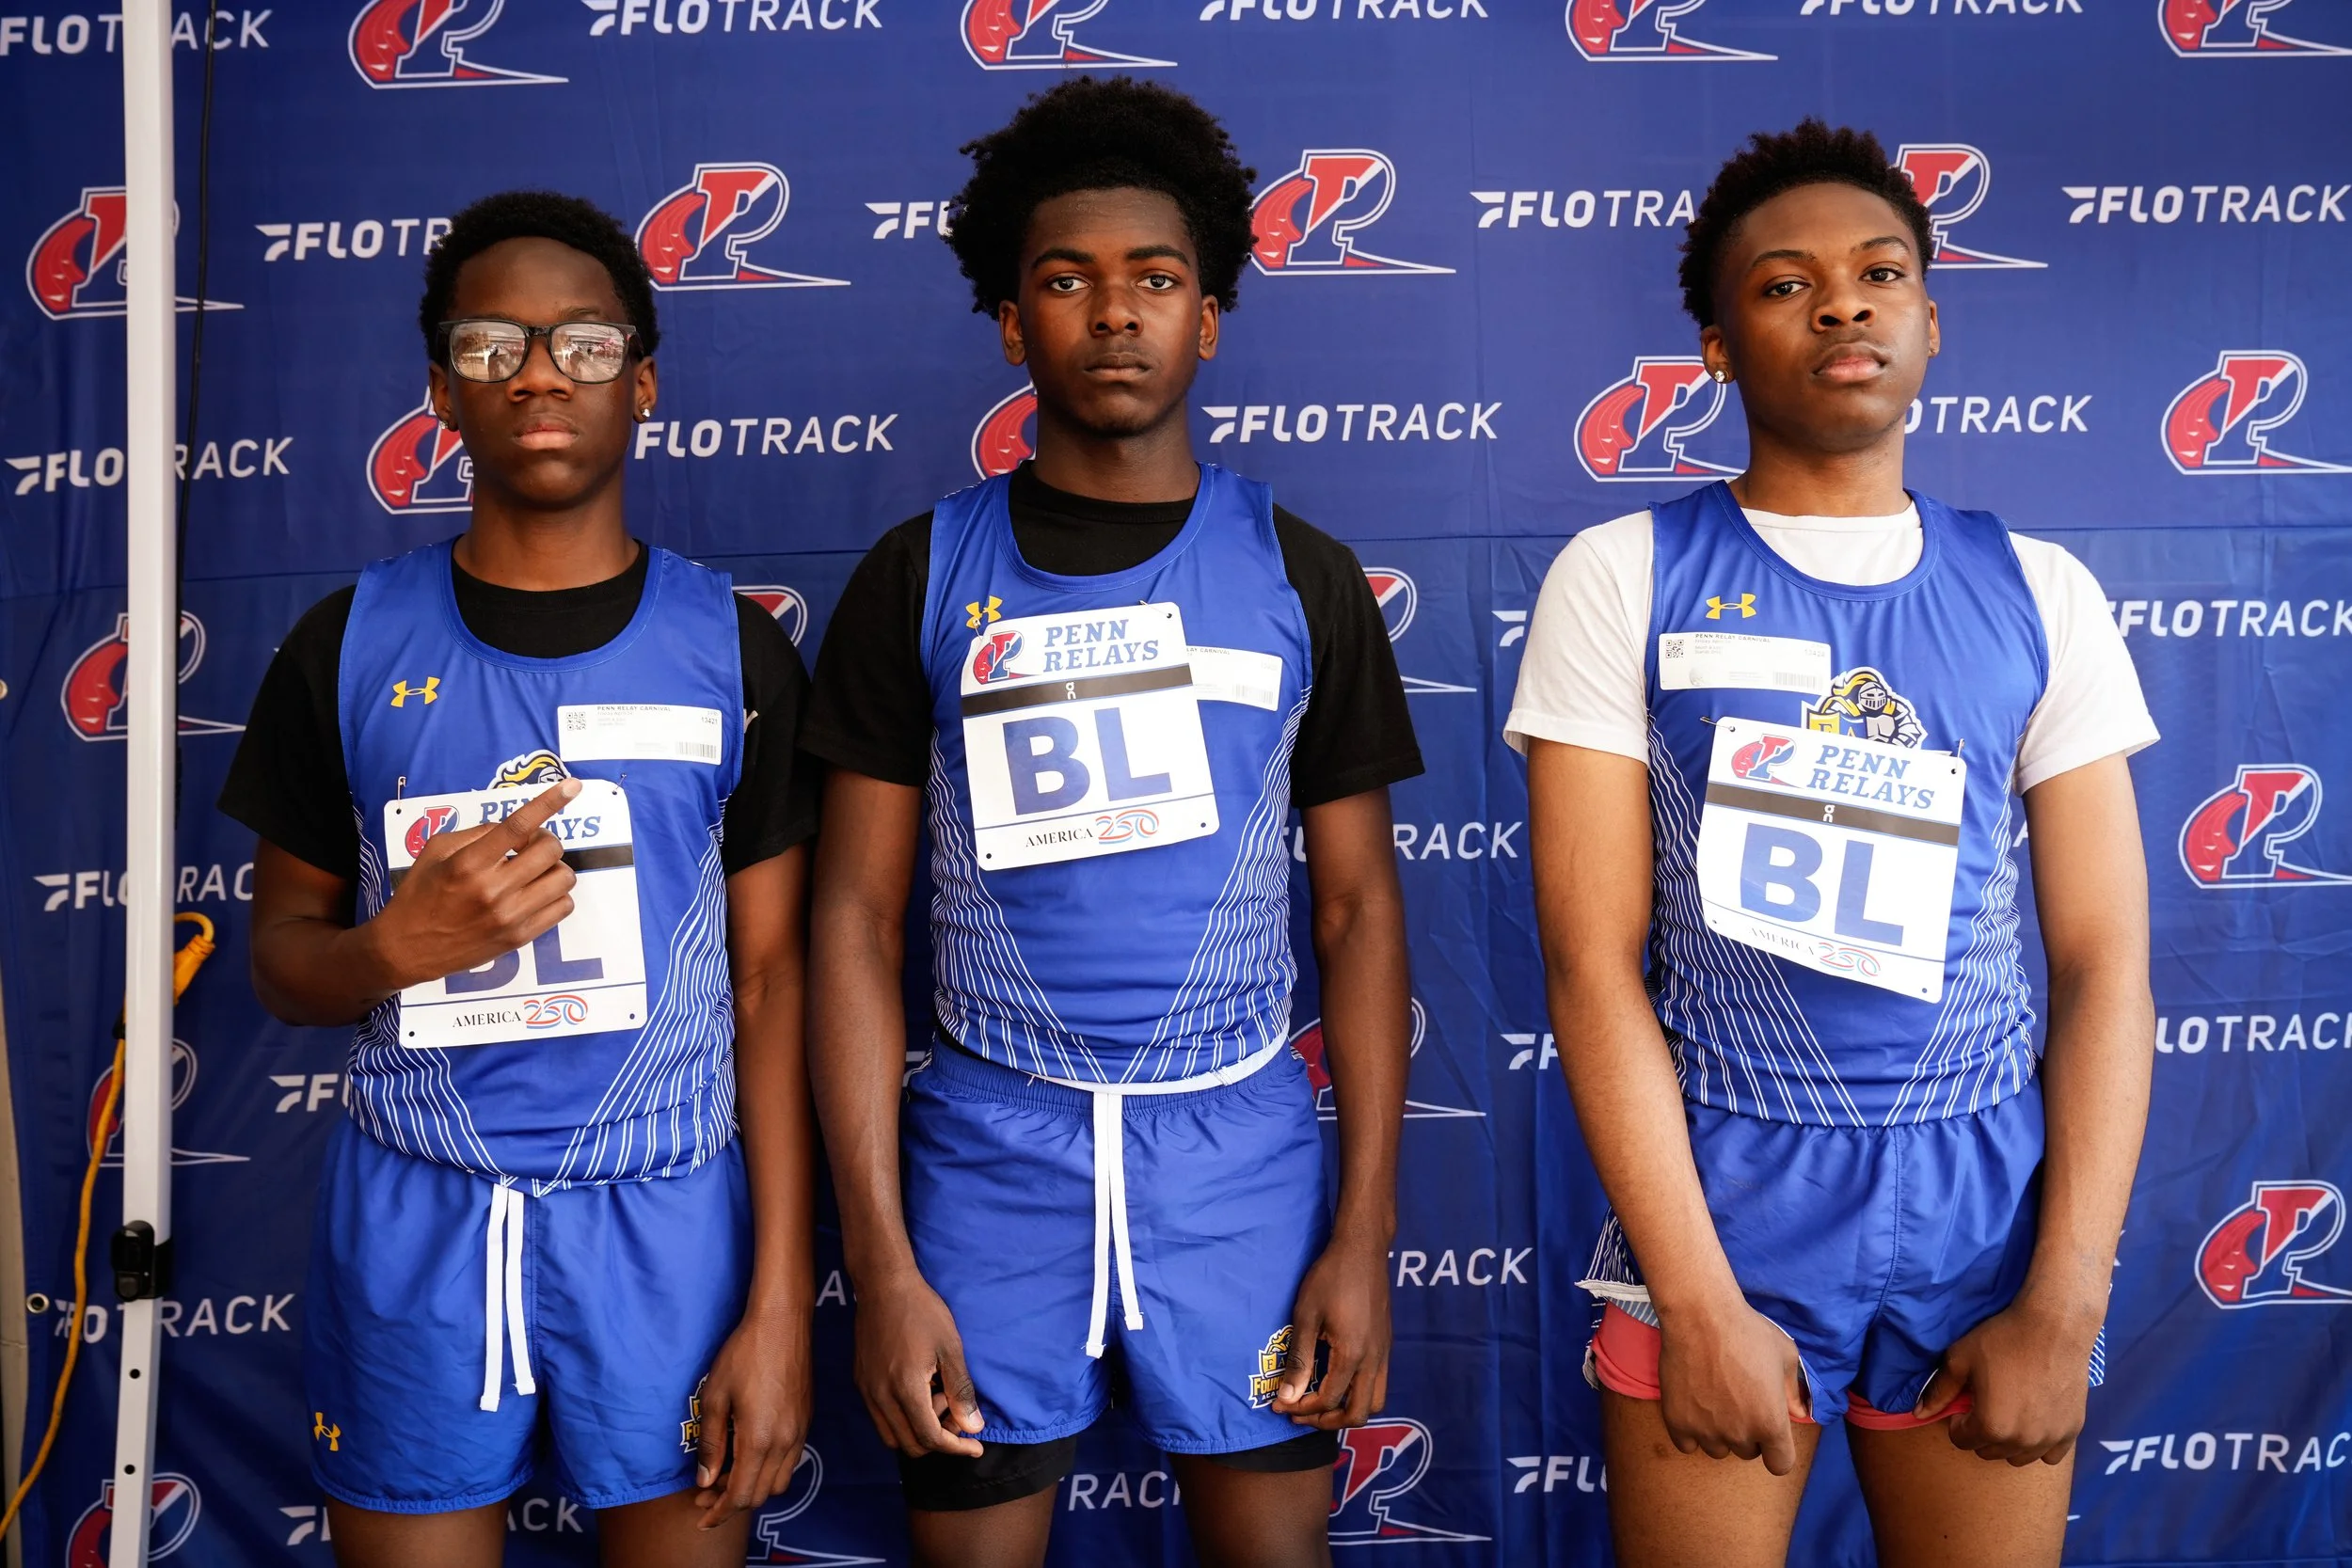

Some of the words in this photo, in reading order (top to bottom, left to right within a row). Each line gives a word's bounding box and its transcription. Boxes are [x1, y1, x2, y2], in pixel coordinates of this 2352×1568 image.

[0, 9, 272, 55] FLOTACK
[620, 0, 882, 35] FLOTRACK
[1508, 190, 1696, 228] FLOTRA
[2098, 184, 2352, 224] FLOTRACK
[294, 217, 453, 261] FLOTR
[1239, 402, 1502, 443] FLOTRACK
[1904, 395, 2092, 435] OTRACK
[634, 414, 898, 459] FLOTRACK
[44, 436, 294, 492] FLOACK
[1044, 619, 1129, 647] PENN
[1042, 640, 1159, 673] RELAYS
[1002, 707, 1173, 816] BL
[1815, 744, 1911, 780] PENN
[1806, 768, 1935, 810] RELAYS
[479, 798, 566, 824] PE
[544, 816, 601, 840] AYS
[1025, 828, 1094, 847] AMERICA
[1095, 809, 1159, 845] 250
[1740, 822, 1904, 947] BL
[1751, 927, 1814, 956] AMERICA
[453, 1010, 521, 1028] AMERICA
[523, 994, 588, 1029] 250
[2154, 1012, 2352, 1053] LOTRAC
[1388, 1247, 1534, 1287] RACK
[2130, 1432, 2352, 1474] FLOTRAC
